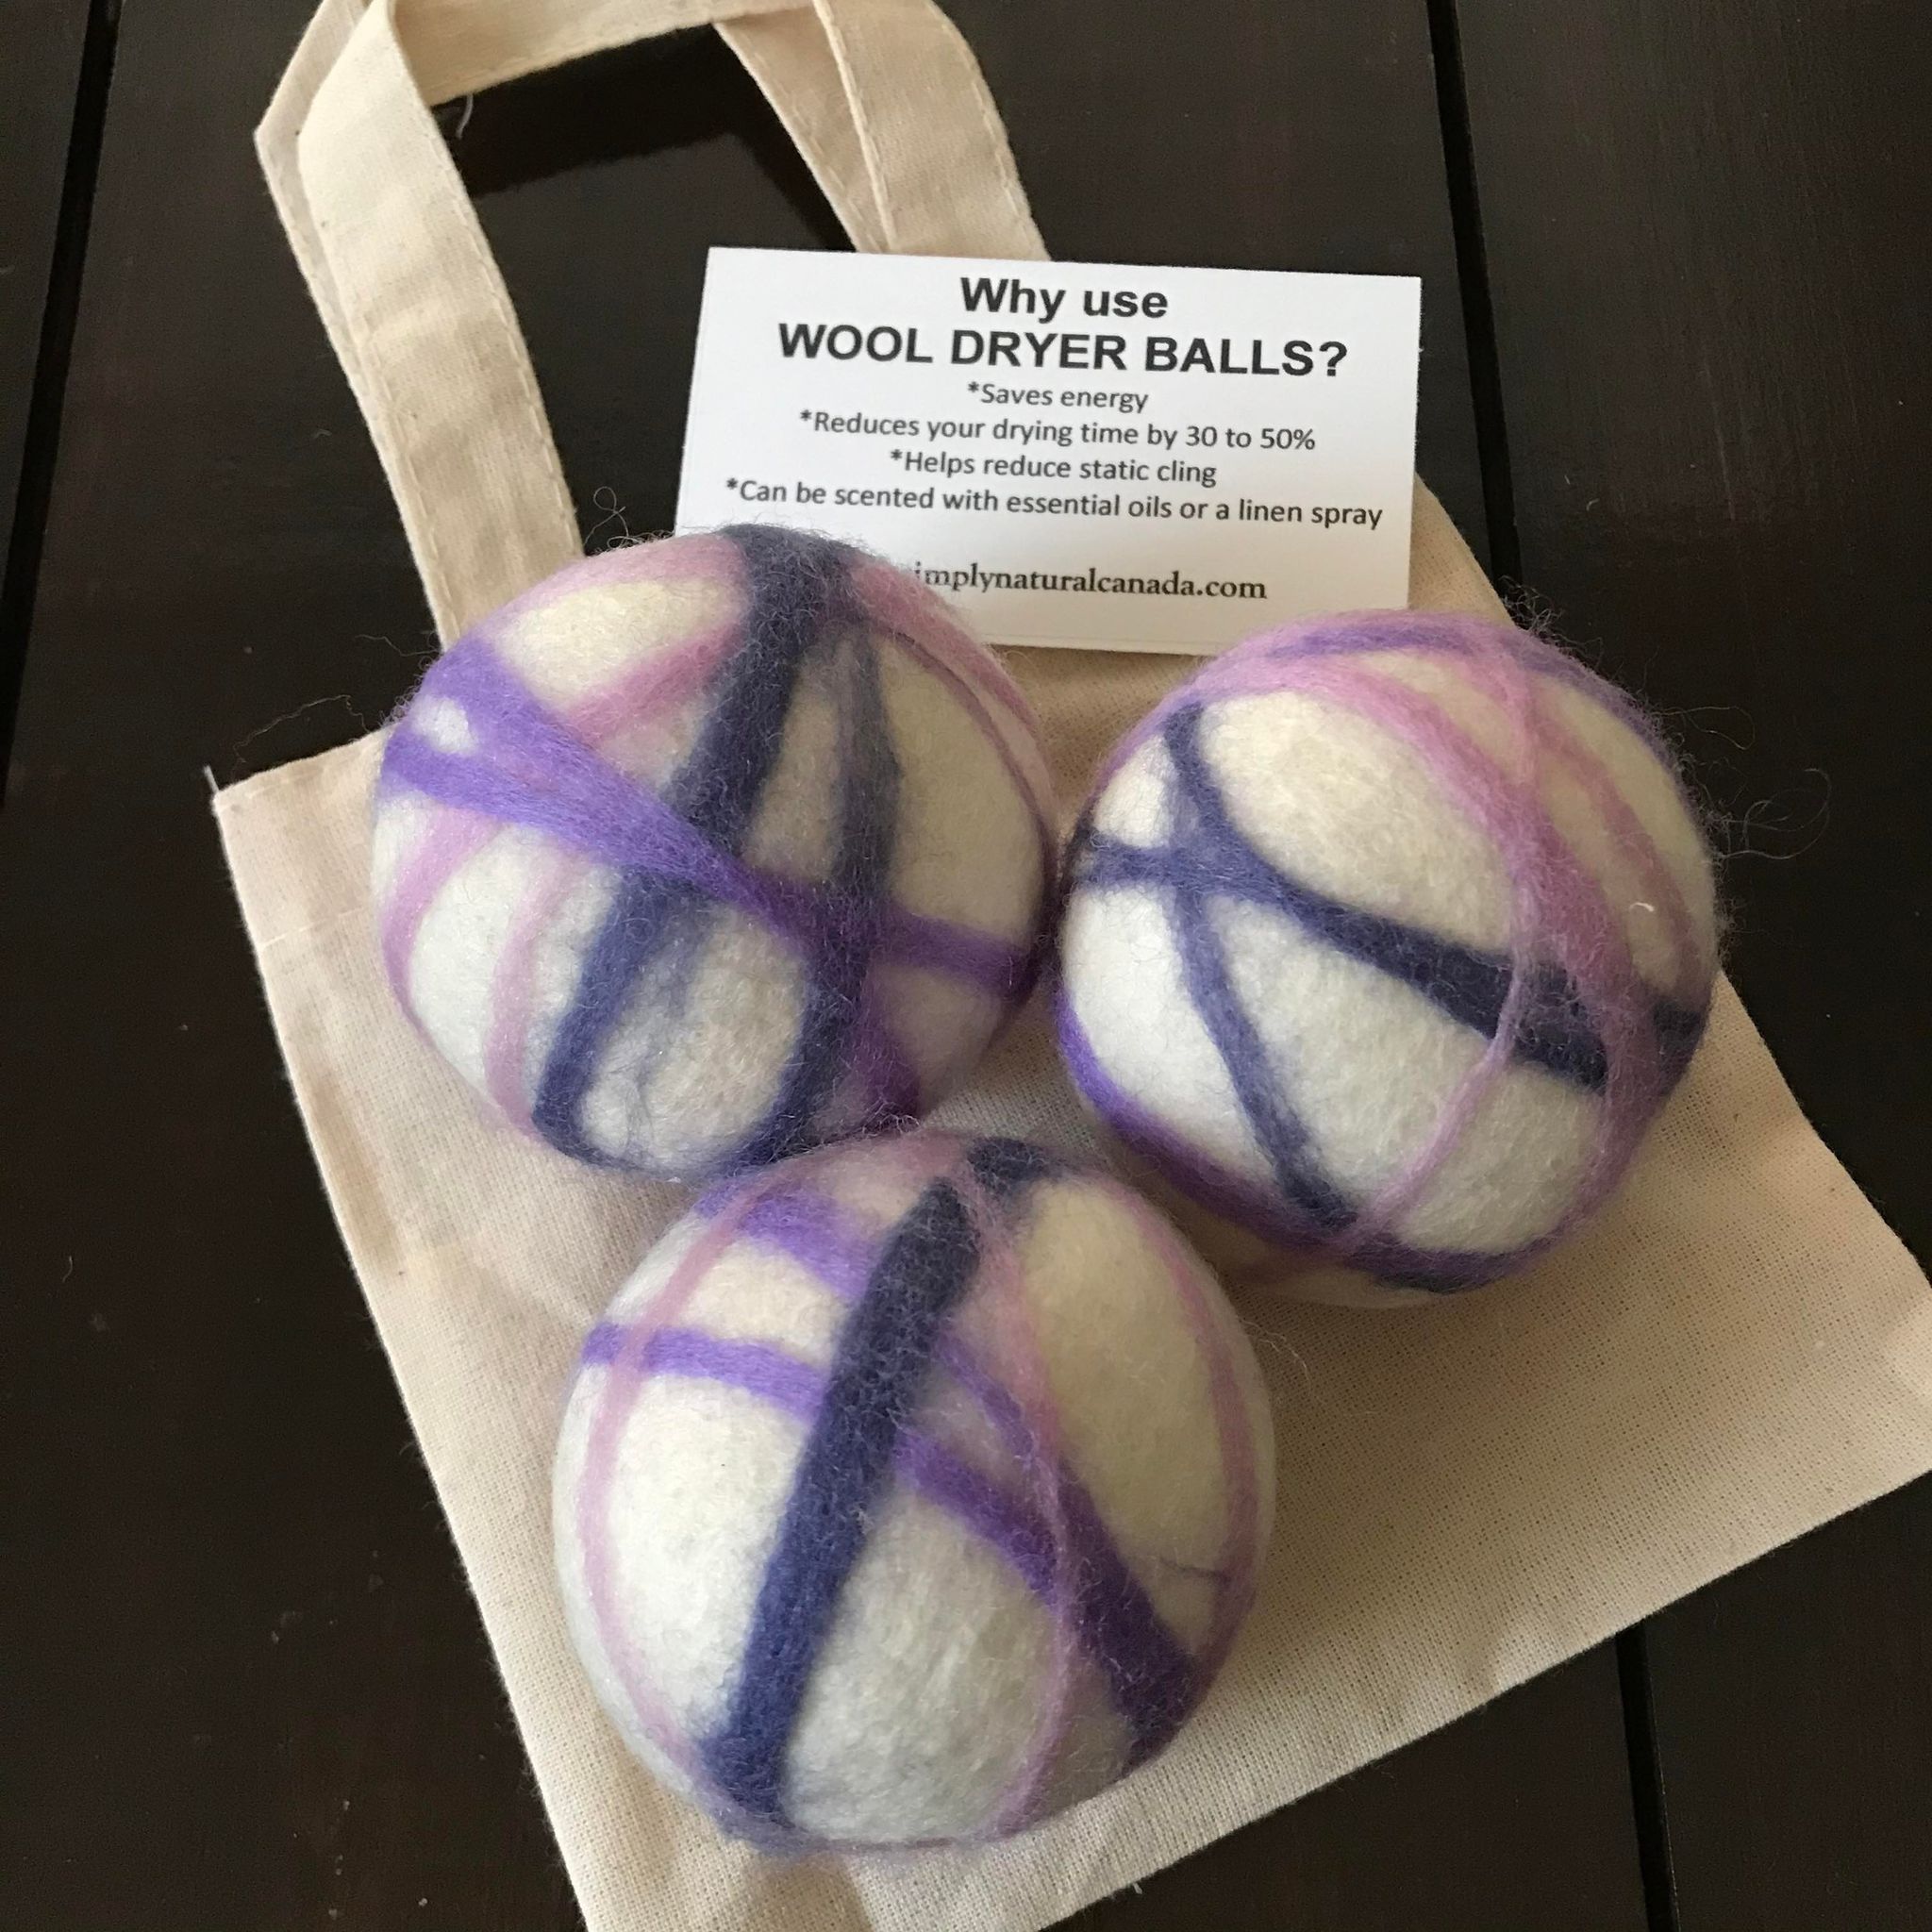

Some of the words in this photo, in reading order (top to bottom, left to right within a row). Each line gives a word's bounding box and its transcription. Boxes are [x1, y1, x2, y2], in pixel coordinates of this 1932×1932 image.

[960, 277, 1066, 324] Why
[1083, 291, 1168, 319] use
[779, 324, 933, 363] WOOL
[951, 329, 1127, 370] DRYER
[1145, 337, 1347, 376] BALLS?
[1060, 391, 1148, 413] energy
[927, 422, 986, 441] your
[993, 419, 1073, 447] drying
[1081, 423, 1139, 444] time
[1147, 424, 1177, 450] by
[1186, 425, 1217, 447] 30
[1225, 428, 1252, 448] to
[1260, 428, 1315, 450] 50%
[984, 455, 1071, 477] reduce
[1079, 459, 1149, 480] static
[1158, 460, 1216, 488] cling
[796, 482, 826, 504] be
[835, 487, 934, 508] scented
[943, 490, 998, 511] with
[1007, 494, 1120, 516] essential
[1128, 496, 1172, 518] oils
[1179, 503, 1208, 519] or
[1216, 504, 1229, 520] a
[1240, 498, 1302, 522] linen
[1311, 507, 1383, 530] spray
[913, 560, 1268, 599] implynaturalcanada.com
